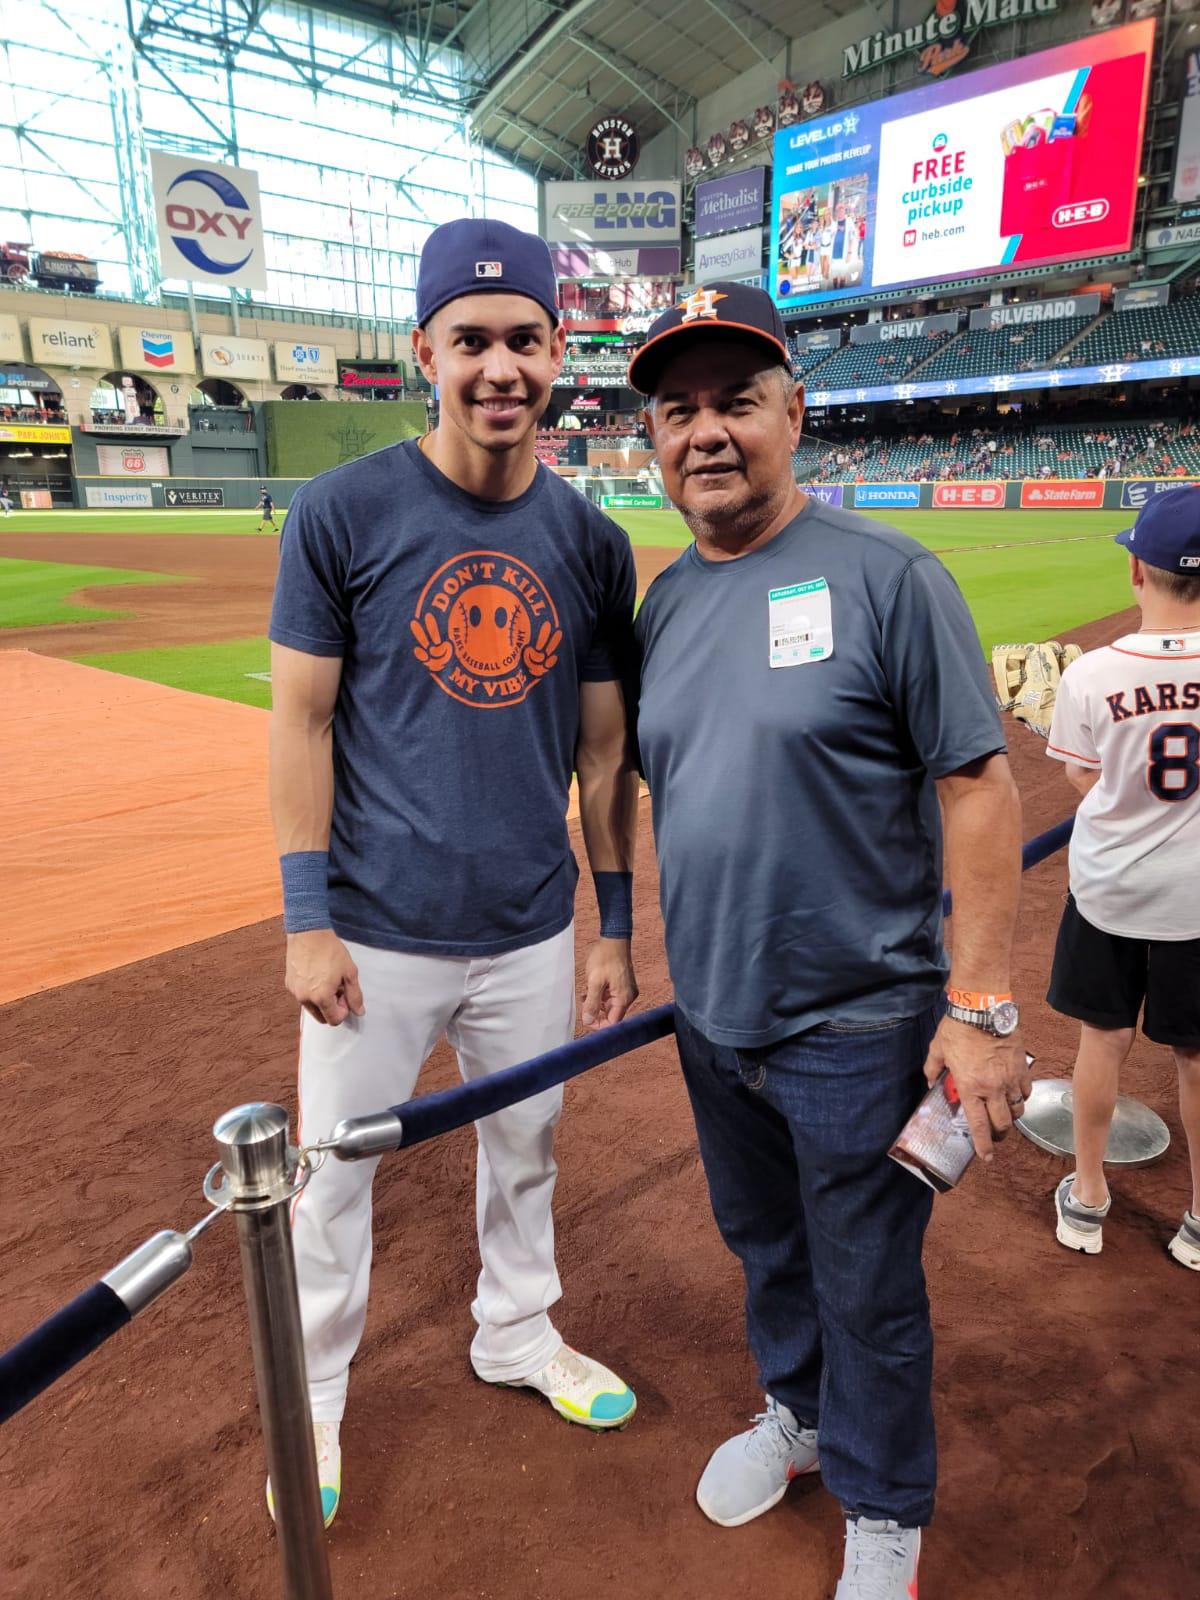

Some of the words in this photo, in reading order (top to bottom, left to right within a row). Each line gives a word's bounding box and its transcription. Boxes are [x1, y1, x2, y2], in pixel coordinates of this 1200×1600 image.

[841, 12, 958, 77] Minute
[964, 0, 1058, 29] Maid
[593, 118, 633, 138] HOUSTON
[790, 129, 827, 149] LEVEL
[827, 123, 843, 139] UP
[602, 137, 622, 159] H
[594, 161, 632, 176] ASTROS
[820, 152, 842, 166] PHOTOS
[912, 151, 966, 184] FREE
[902, 176, 973, 205] curbside
[552, 202, 660, 219] FREEPORT
[594, 191, 676, 229] LNG
[908, 197, 964, 225] pickup
[165, 204, 253, 240] OXY
[921, 224, 965, 241] heb.com
[991, 300, 1076, 325] SILVERADO
[42, 331, 96, 349] reliant
[141, 330, 173, 341] Chevron
[880, 320, 925, 341] CHEVY
[588, 376, 627, 387] impact
[104, 492, 149, 504] Insperity
[179, 492, 220, 500] VERITEX
[868, 491, 916, 500] HONDA
[432, 562, 495, 613] DON'T
[501, 566, 546, 616] KILL
[462, 652, 501, 671] BASEBALL
[502, 629, 527, 667] COMPANY
[448, 666, 481, 694] MY
[482, 670, 527, 697] VIBE
